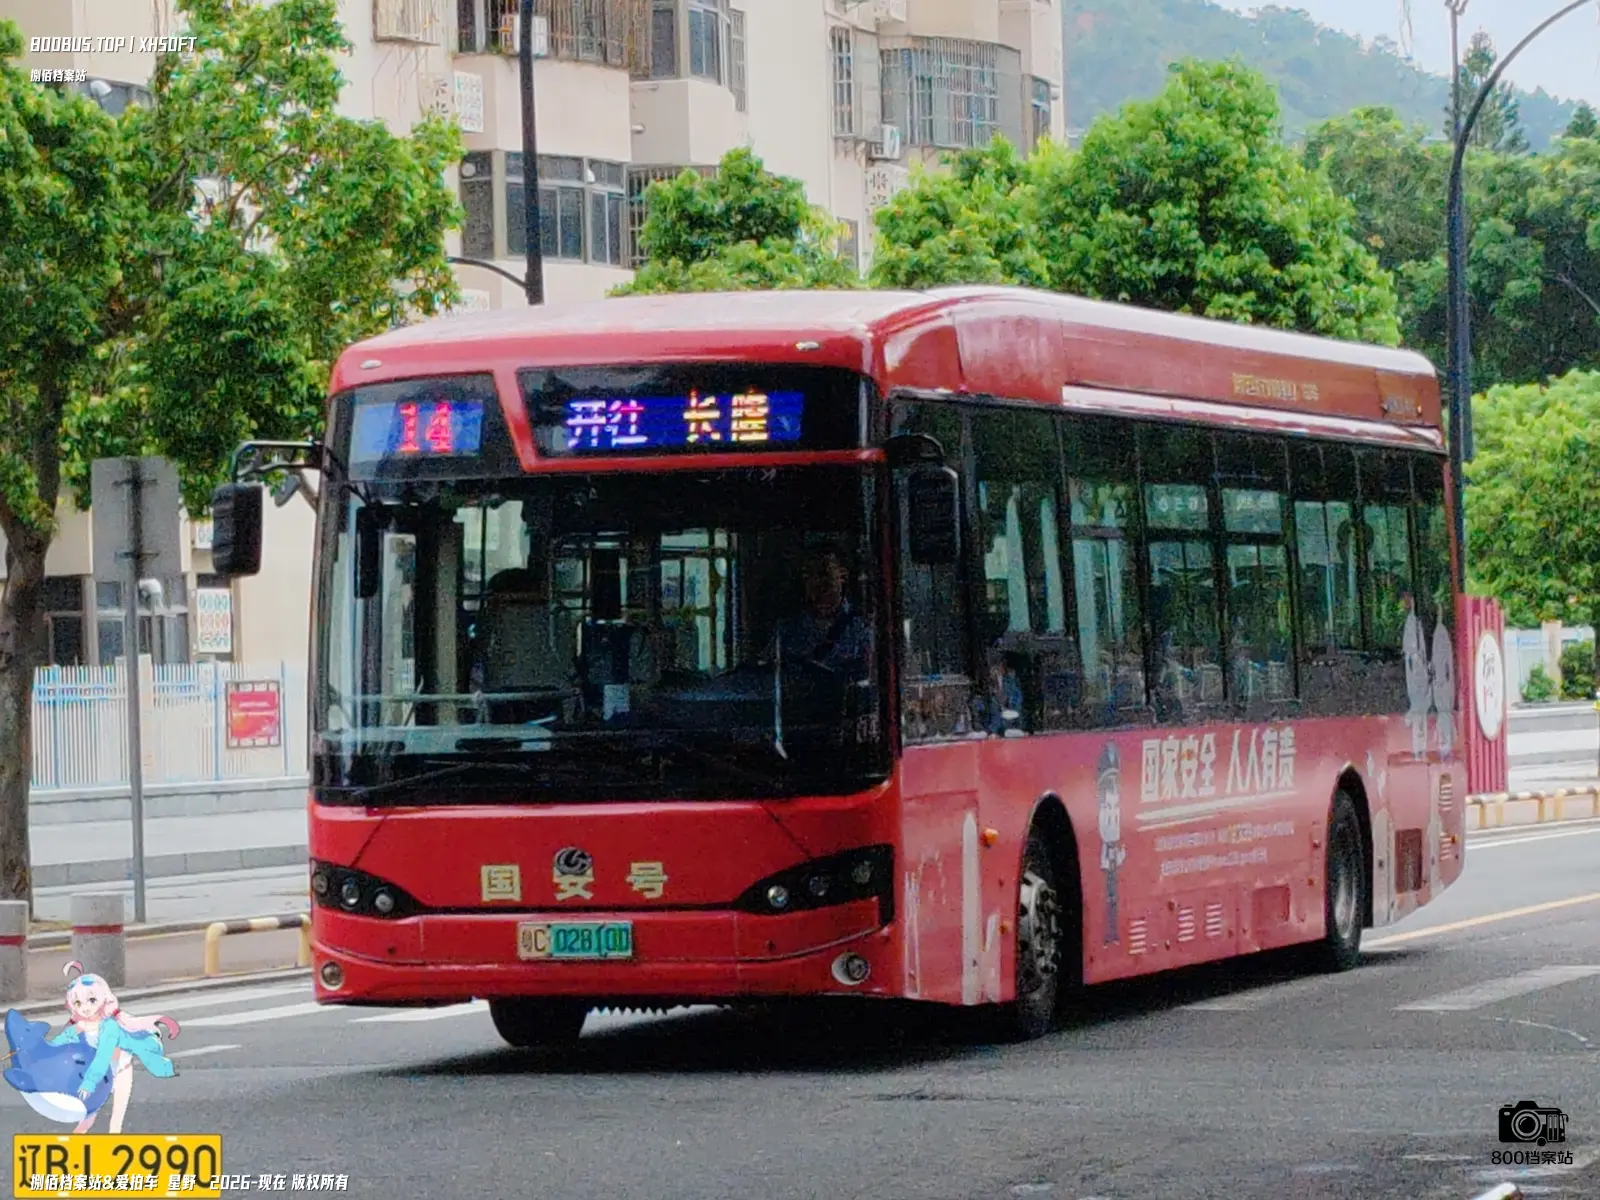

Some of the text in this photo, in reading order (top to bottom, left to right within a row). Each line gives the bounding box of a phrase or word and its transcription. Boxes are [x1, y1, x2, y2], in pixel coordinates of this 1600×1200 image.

[399, 402, 453, 454] 14
[567, 400, 648, 447] 开往
[1141, 726, 1297, 803] 国家安全 人人有责
